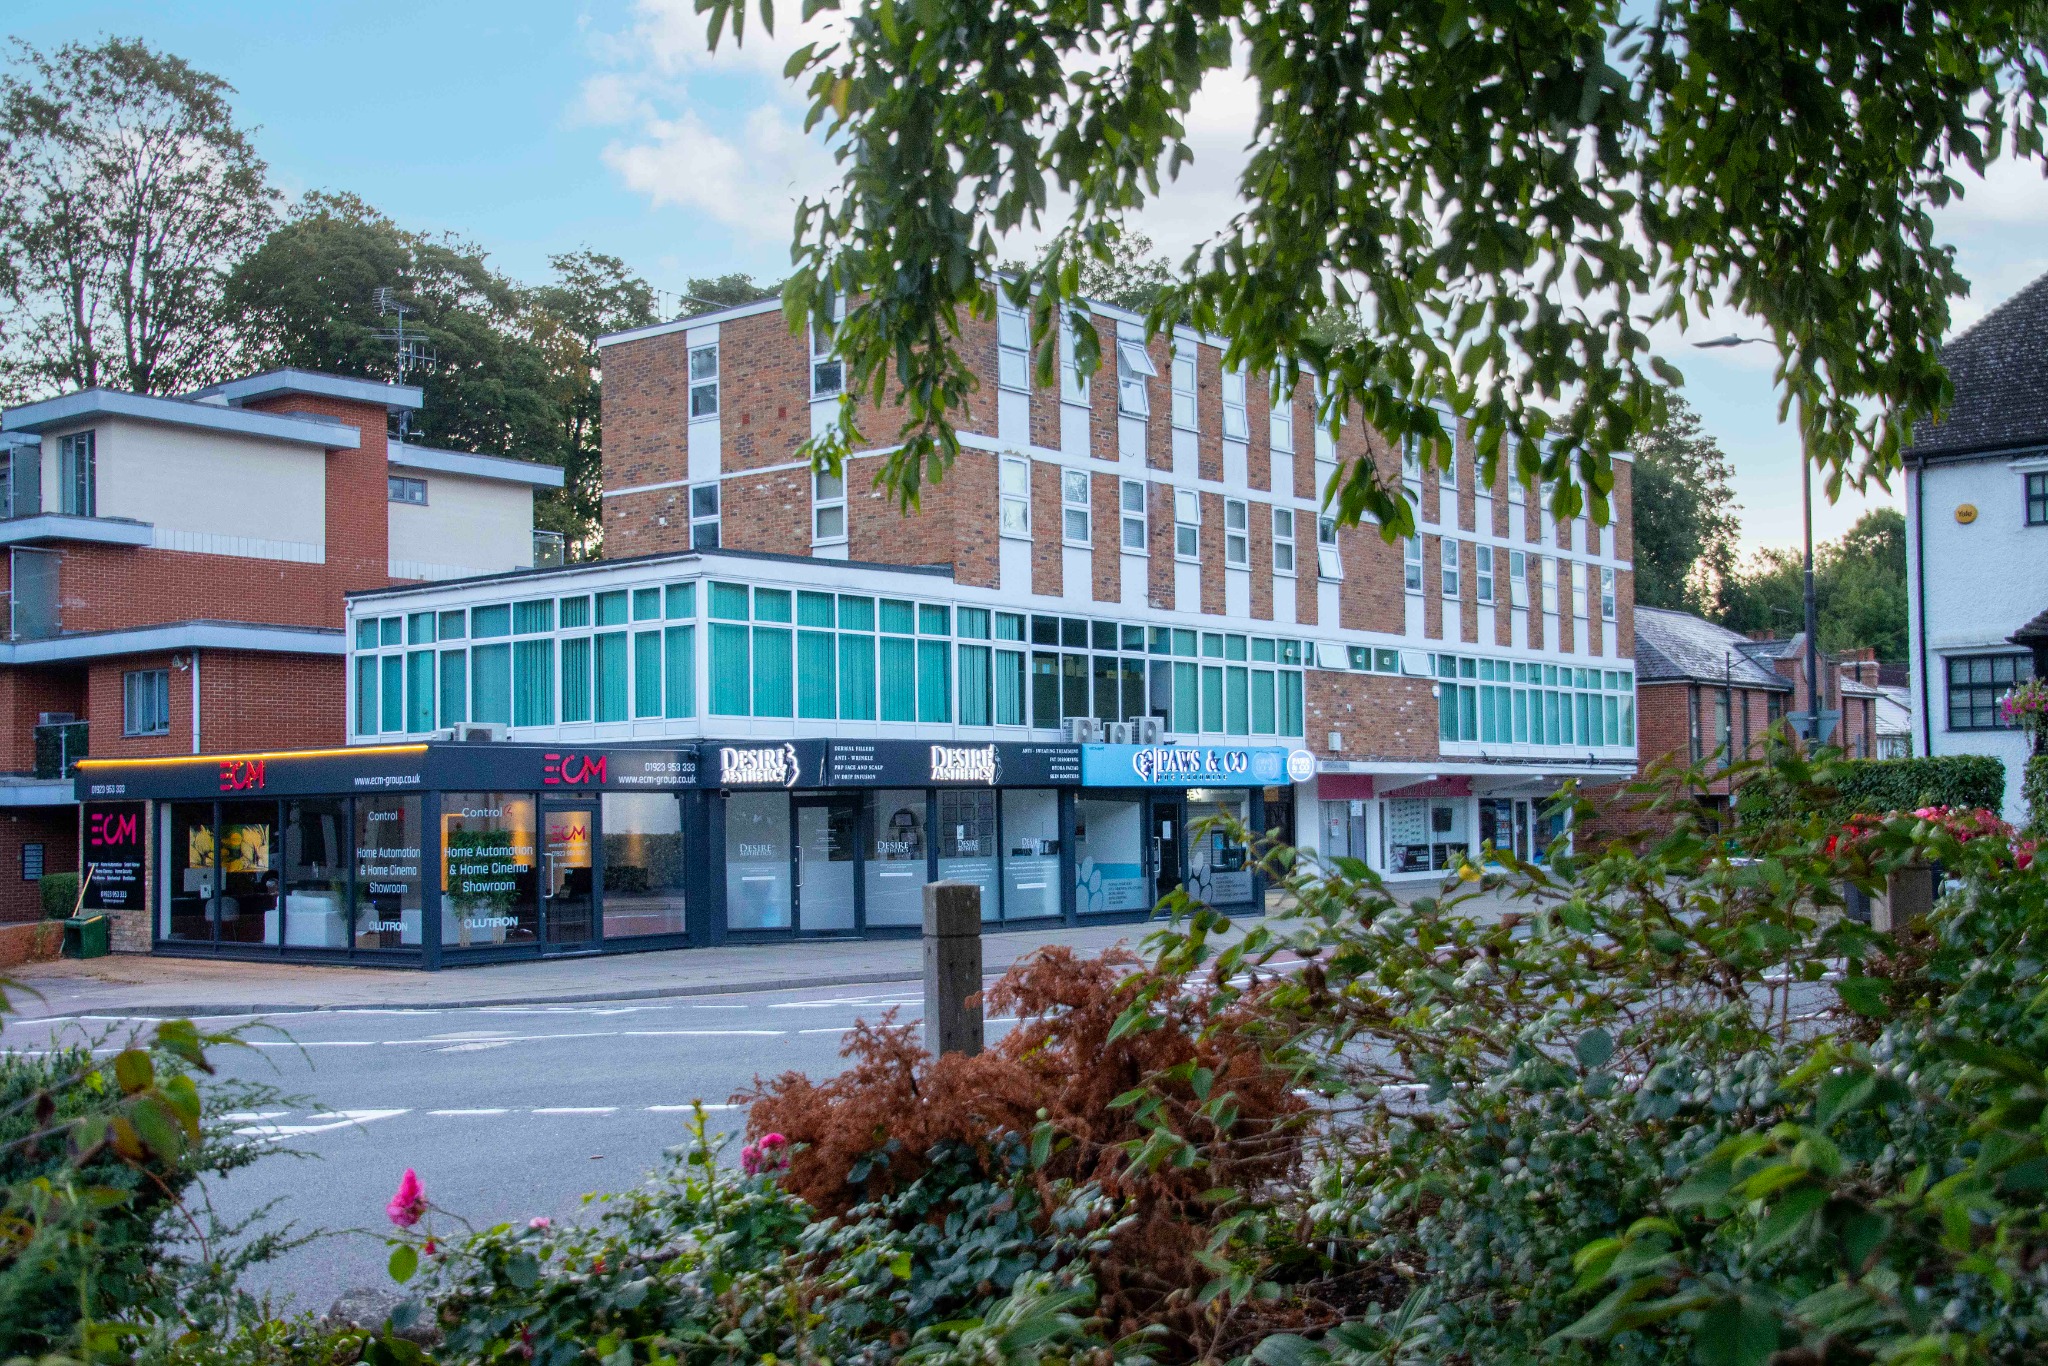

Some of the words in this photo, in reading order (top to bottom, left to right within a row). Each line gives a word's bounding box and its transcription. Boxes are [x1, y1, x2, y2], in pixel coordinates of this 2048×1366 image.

[720, 747, 785, 770] DESIRE
[931, 746, 992, 769] DESIRE
[1158, 750, 1200, 772] PAWS
[1206, 750, 1221, 772] &
[1224, 751, 1249, 773] CO
[544, 754, 607, 784] ECM
[645, 762, 666, 772] 01923
[667, 762, 681, 772] 953
[682, 762, 695, 772] 333
[220, 760, 264, 790] ECM
[355, 773, 420, 786] www.ecm-group.co.uk
[618, 774, 696, 785] www.ecm-group.co.uk
[720, 768, 785, 783] AESTHETICS
[92, 786, 105, 794] 01923
[91, 813, 136, 845] ECM
[552, 825, 586, 841] ECM
[740, 844, 772, 852] DESIRE
[877, 841, 909, 850] DESIRE
[357, 848, 377, 858] Home
[379, 846, 421, 858] Automation
[444, 847, 473, 858] Home
[476, 846, 533, 858] Automation
[360, 865, 366, 875] &
[368, 865, 388, 876] Home
[390, 864, 417, 875] Cinema
[449, 864, 457, 875] &
[460, 864, 489, 874] Home
[491, 862, 528, 874] Cinema
[369, 882, 408, 894] Showroom
[462, 881, 516, 892] Showroom
